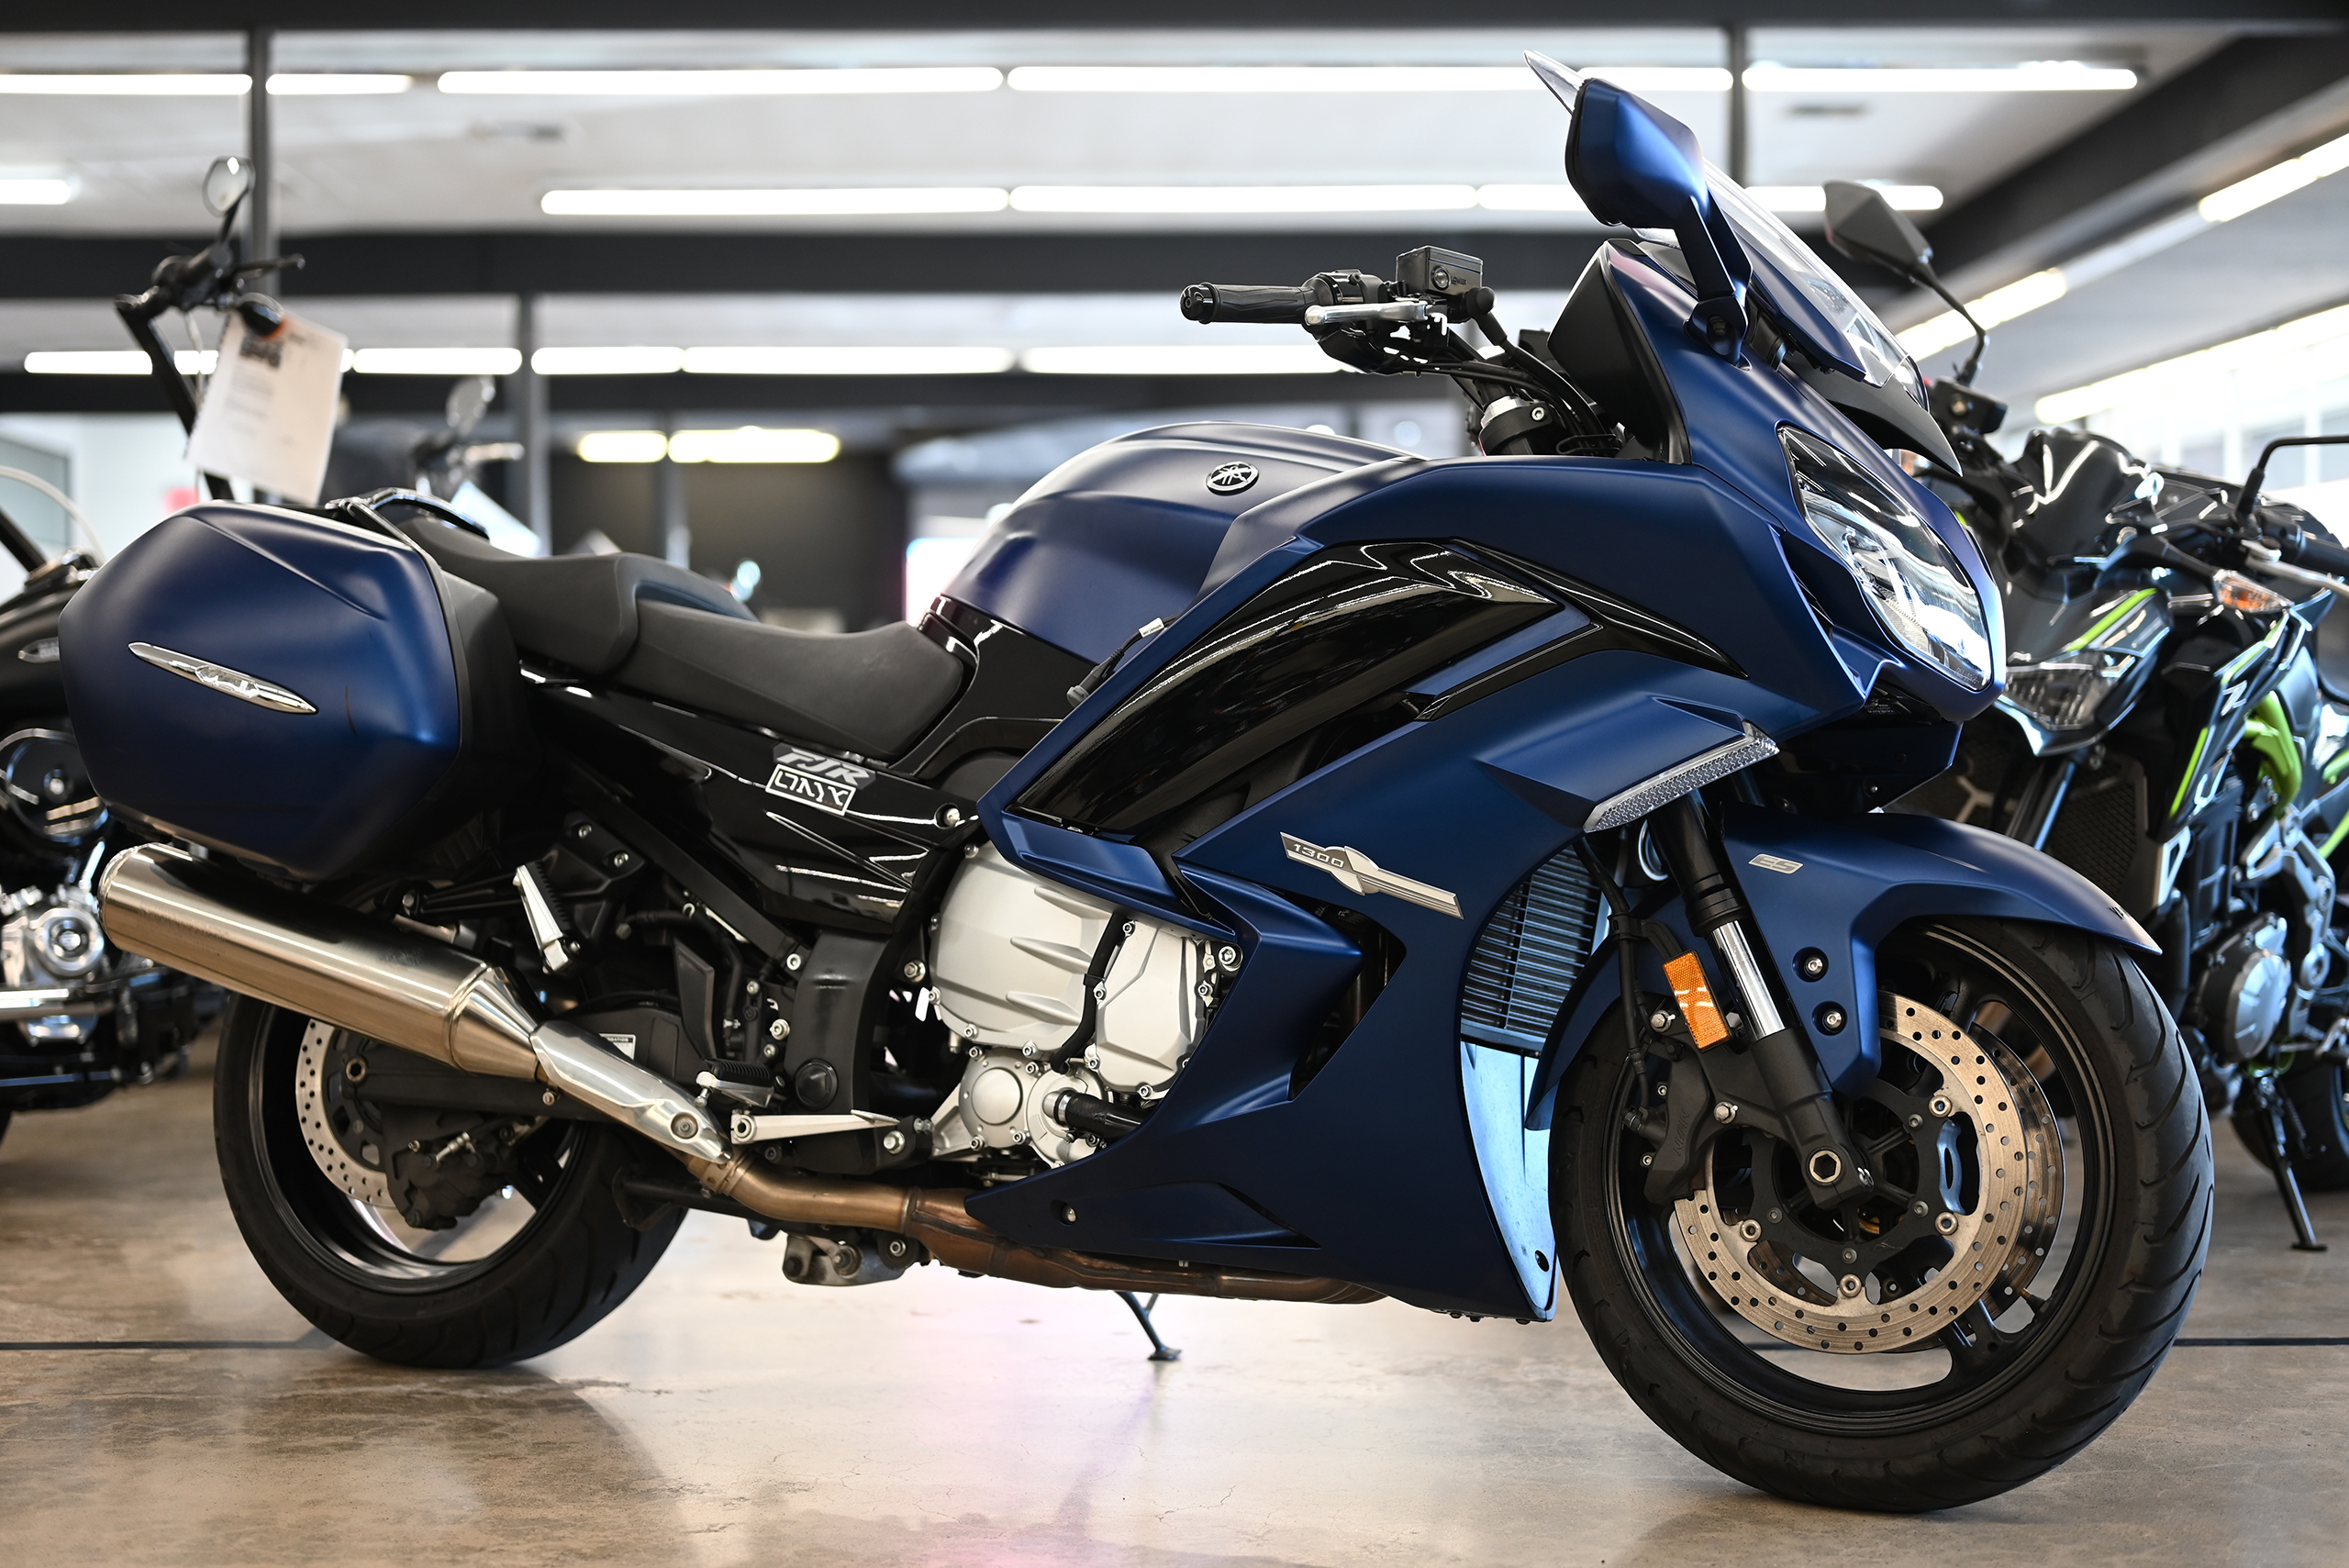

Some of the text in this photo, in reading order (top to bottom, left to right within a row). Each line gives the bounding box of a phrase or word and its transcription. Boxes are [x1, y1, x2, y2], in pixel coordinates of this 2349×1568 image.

[776, 747, 870, 786] FJR
[774, 771, 849, 806] ONYX
[1293, 843, 1345, 869] 1300
